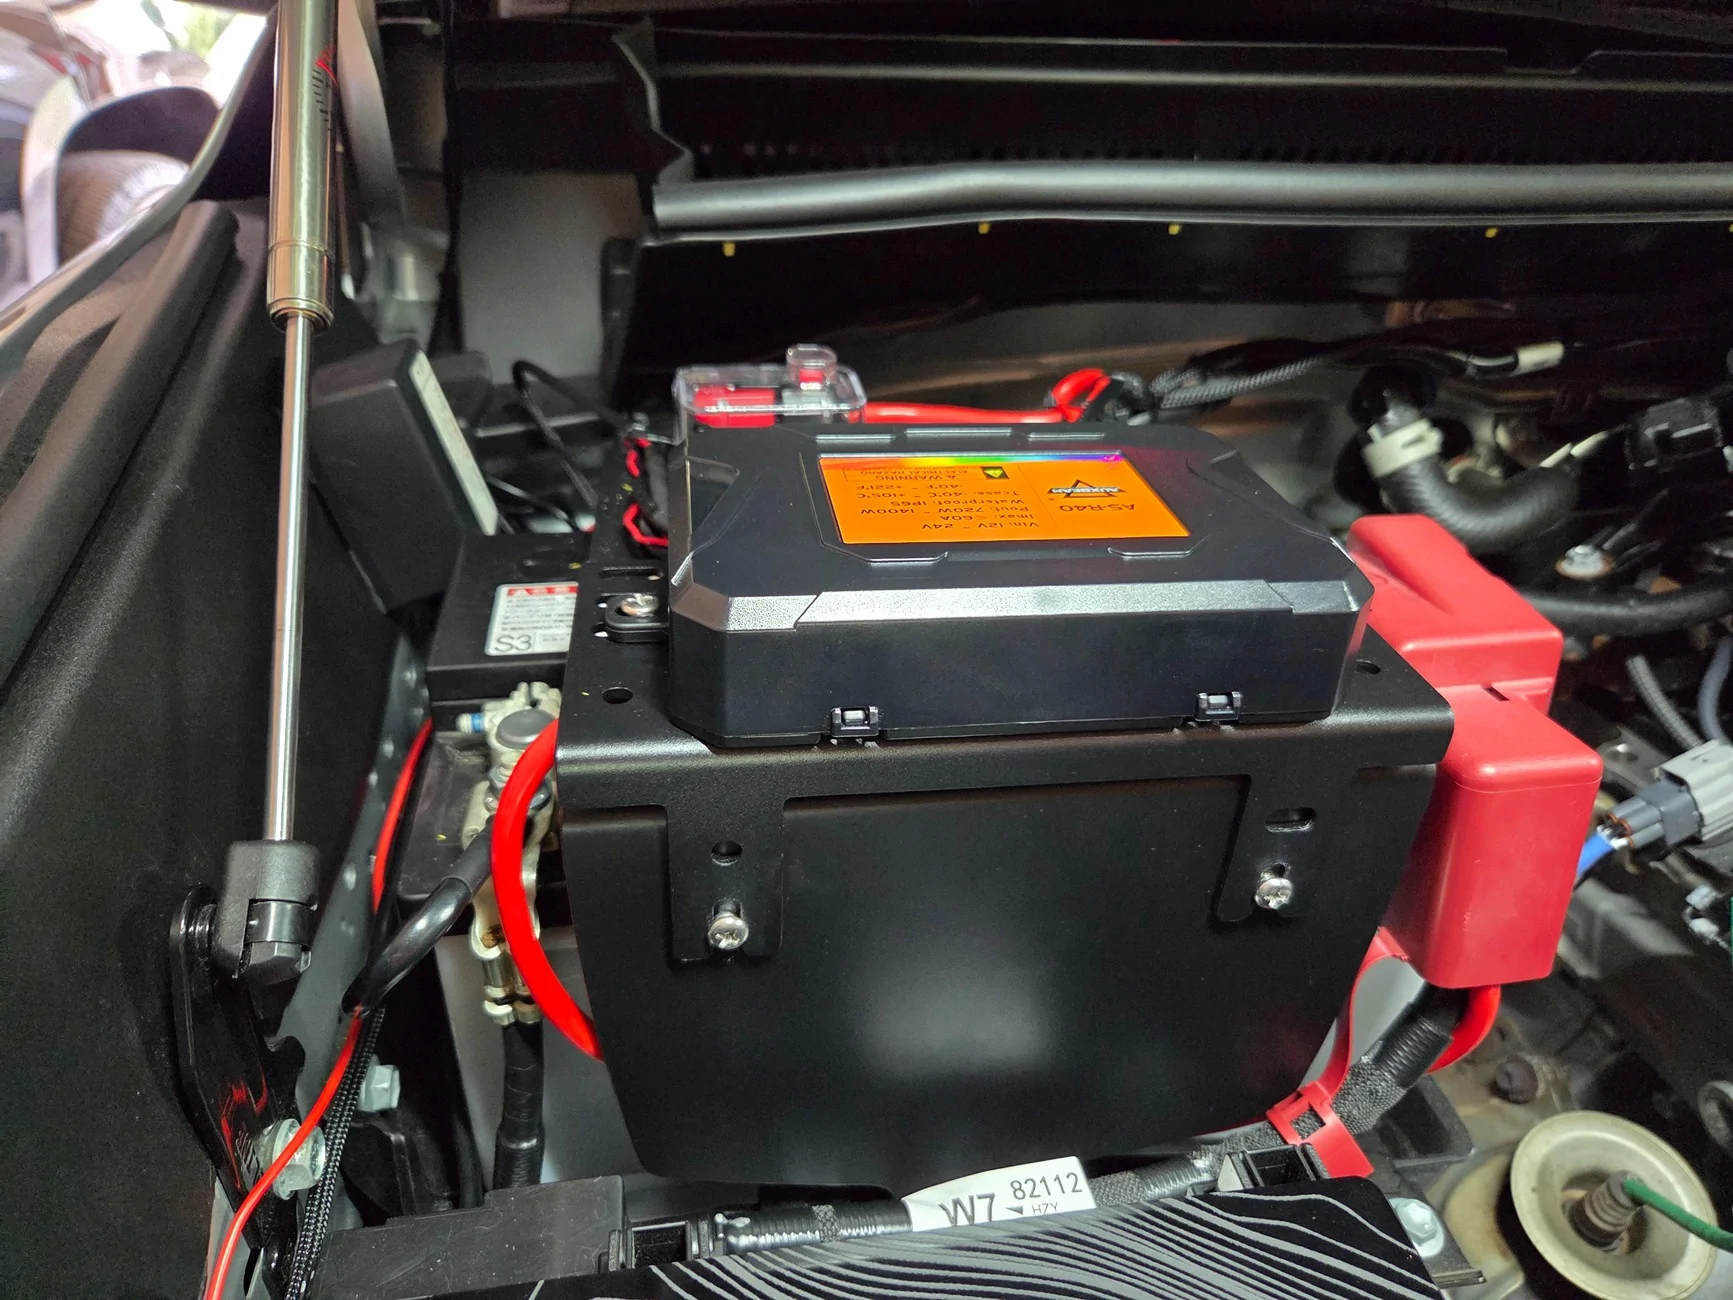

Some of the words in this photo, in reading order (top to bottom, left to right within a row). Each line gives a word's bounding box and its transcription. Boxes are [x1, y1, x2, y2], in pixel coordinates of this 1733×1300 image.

[1050, 486, 1120, 494] AUXBEAM
[1059, 503, 1135, 512] AS-R40
[494, 634, 533, 652] S3
[1010, 1171, 1083, 1201] 82112
[938, 1192, 995, 1226] W7
